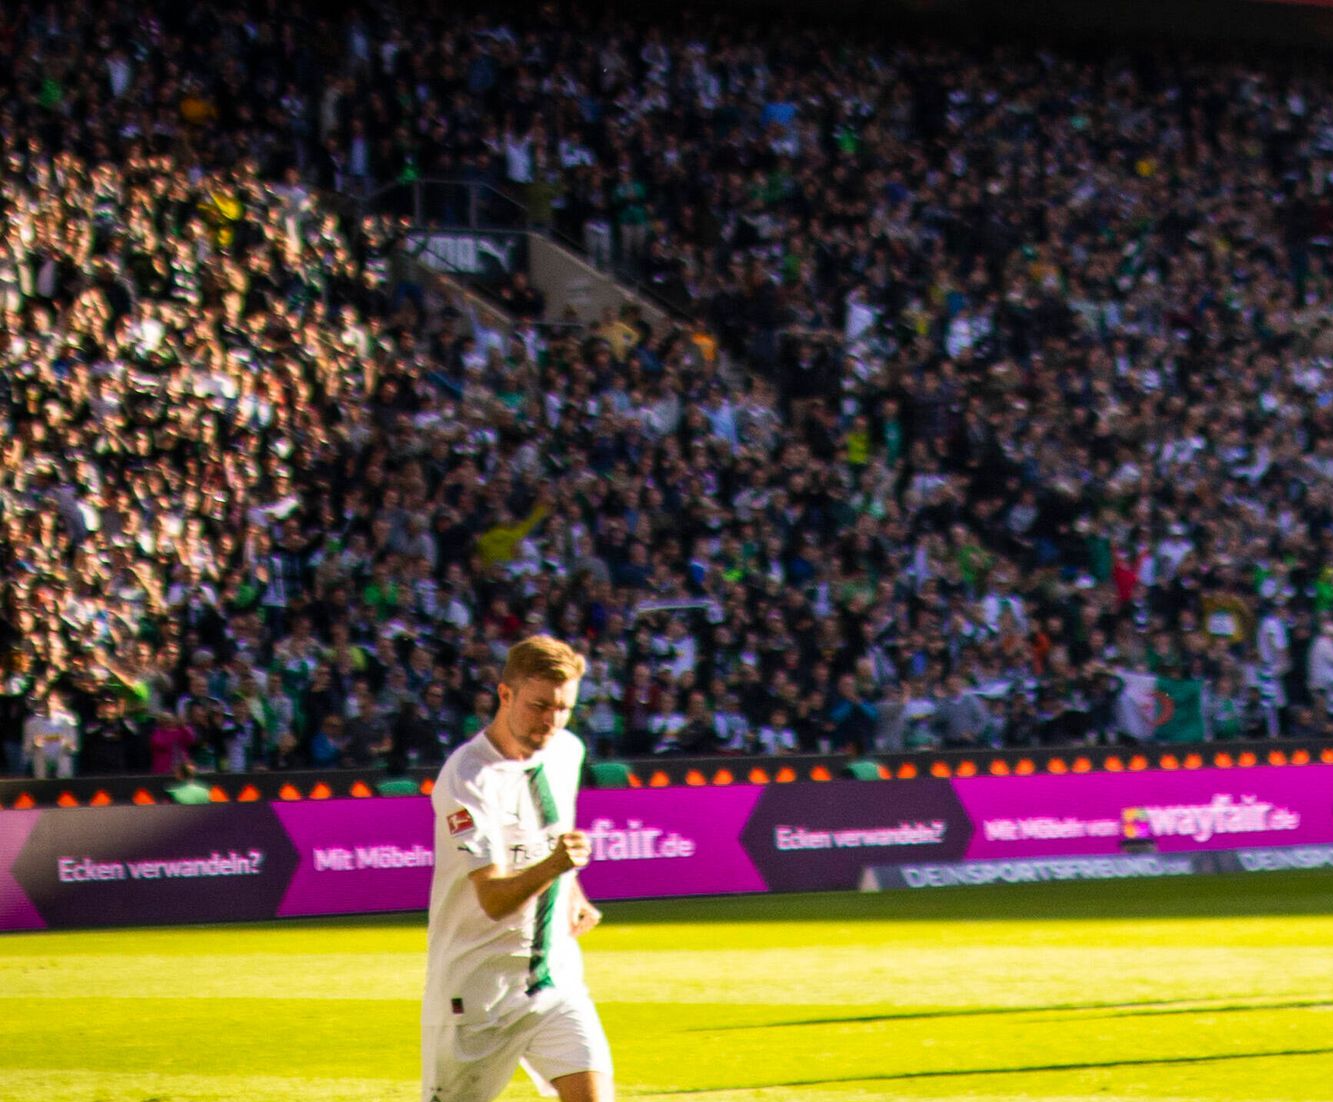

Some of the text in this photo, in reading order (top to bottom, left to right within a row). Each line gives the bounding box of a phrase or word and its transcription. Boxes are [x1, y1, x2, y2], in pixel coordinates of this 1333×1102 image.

[1150, 793, 1301, 842] wayfair.de
[588, 817, 696, 862] fair.de
[775, 824, 831, 851] Ecken
[57, 848, 265, 883] Ecken verwandeln?
[313, 844, 434, 872] Mit Möbeln
